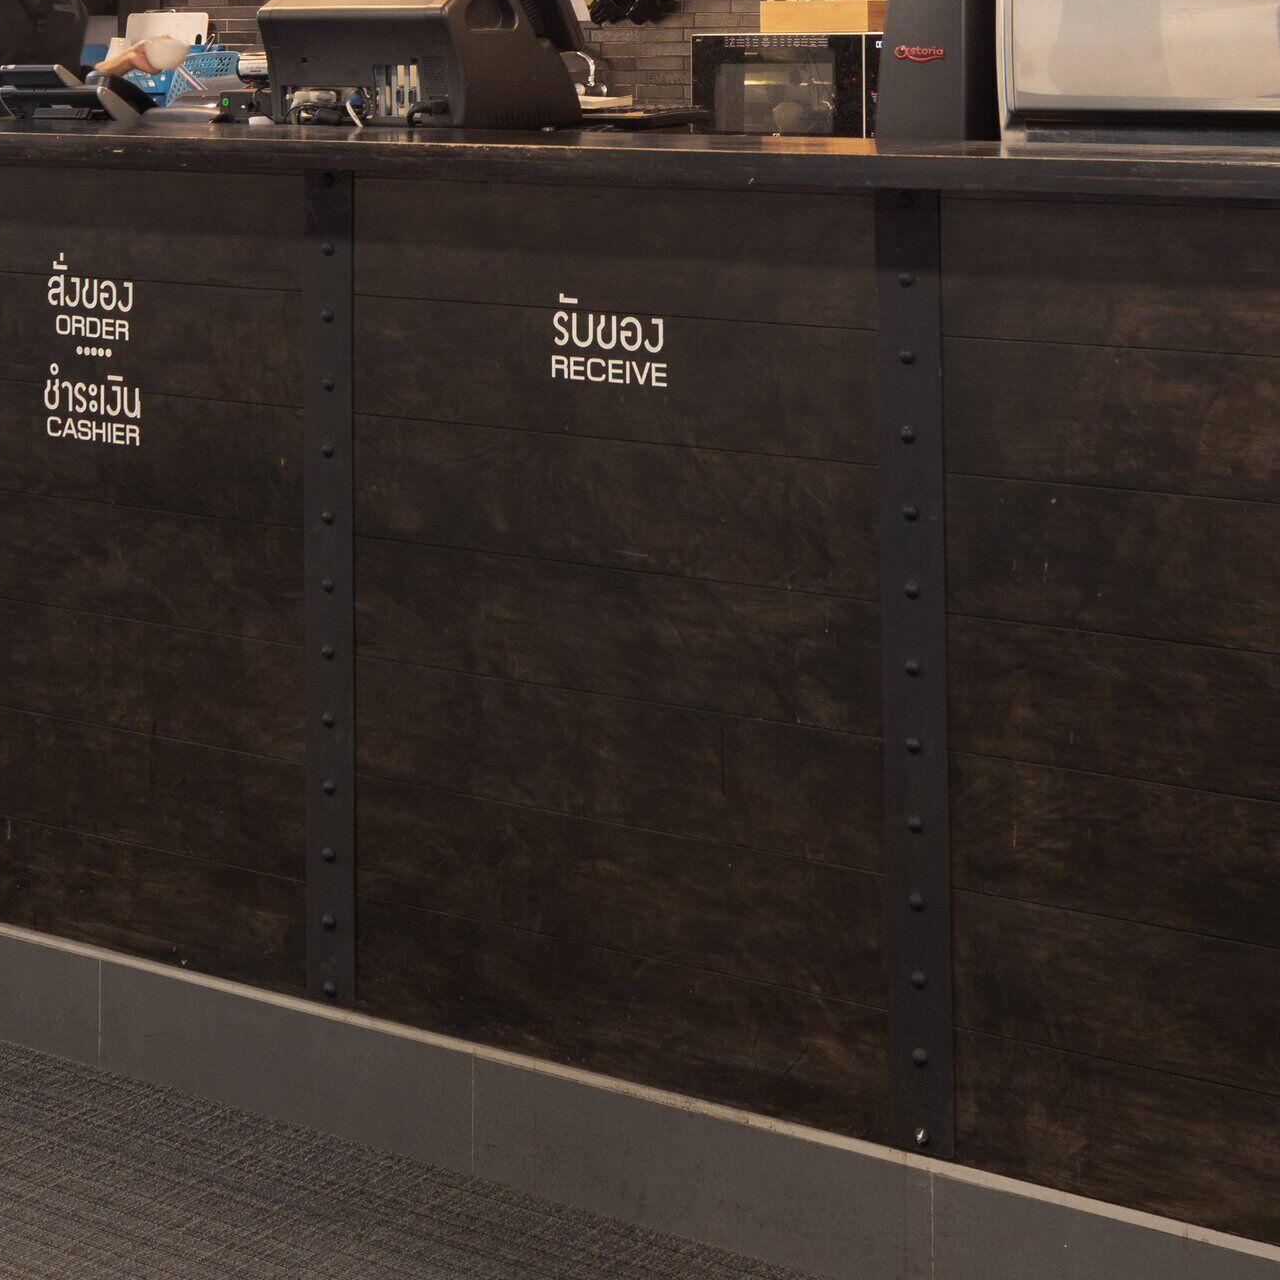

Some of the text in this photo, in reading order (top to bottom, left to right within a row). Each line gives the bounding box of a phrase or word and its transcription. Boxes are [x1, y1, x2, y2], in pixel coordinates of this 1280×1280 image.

[48, 252, 133, 312] สั่งของ
[55, 314, 129, 341] ORDER
[553, 293, 664, 354] รับของ
[44, 363, 141, 419] ชำระเงิน
[551, 355, 667, 387] RECEIVE
[46, 416, 140, 446] CASHIER
